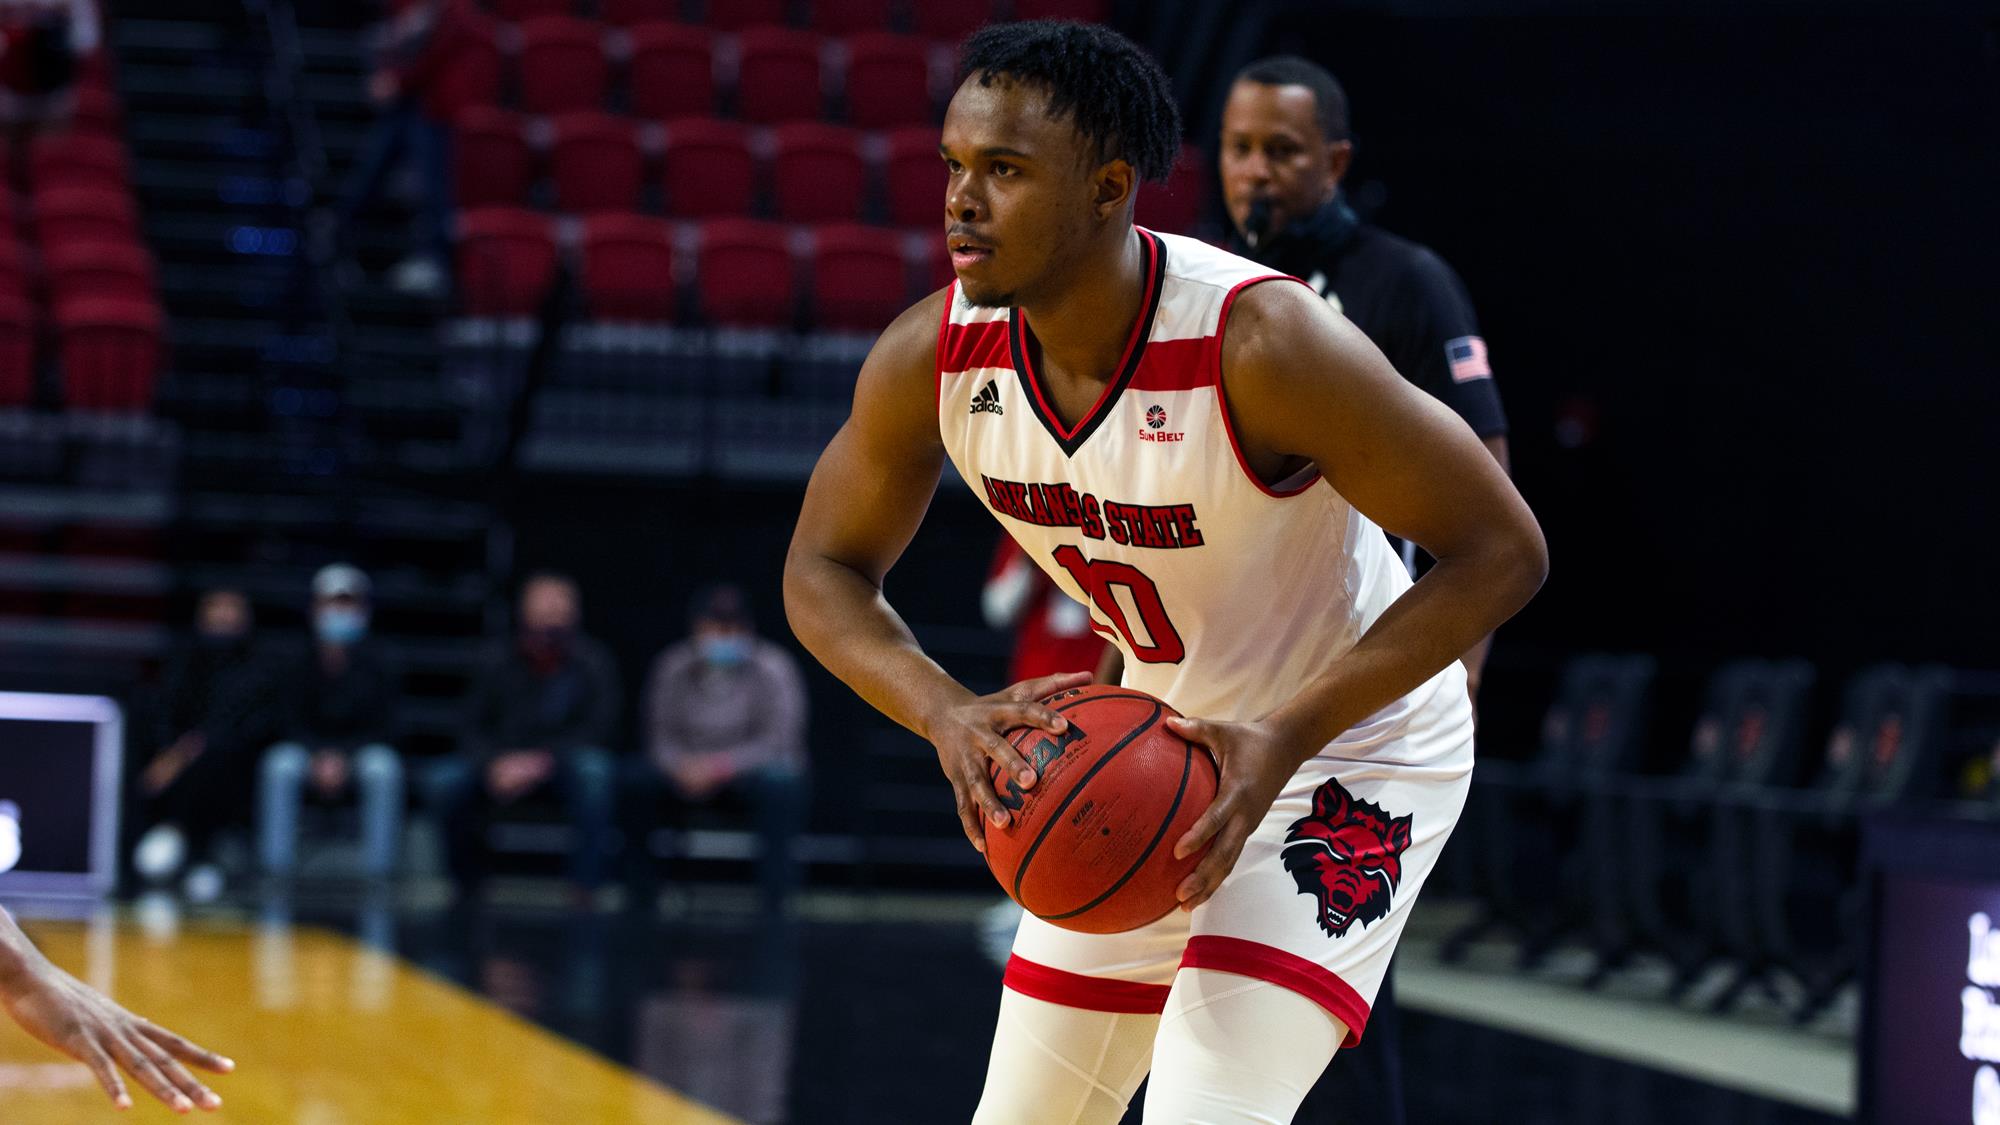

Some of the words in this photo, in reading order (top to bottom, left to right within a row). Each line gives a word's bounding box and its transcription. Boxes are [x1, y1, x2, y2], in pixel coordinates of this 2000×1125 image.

[970, 400, 1004, 416] adidas
[1157, 431, 1185, 443] BELT
[1102, 499, 1206, 549] STATE
